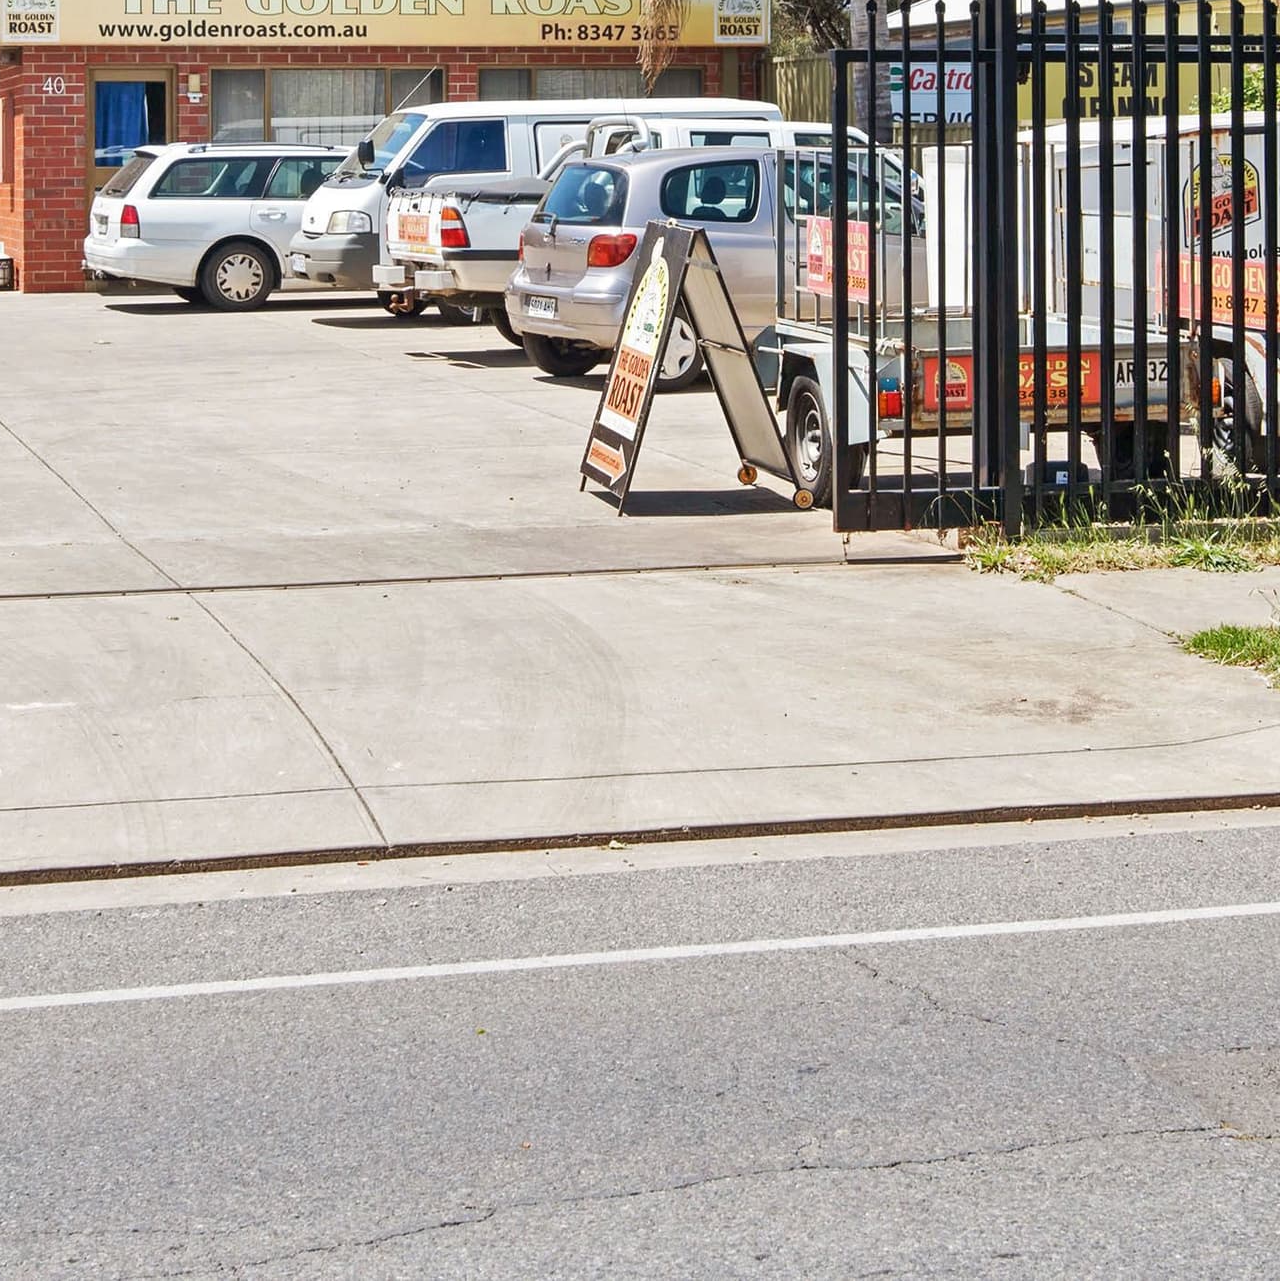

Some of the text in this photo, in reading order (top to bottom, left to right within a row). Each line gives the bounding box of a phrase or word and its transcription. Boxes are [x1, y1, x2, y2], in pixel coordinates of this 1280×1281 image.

[24, 13, 55, 21] GOLDEN
[9, 21, 53, 34] ROAST
[99, 20, 368, 42] www.goldenroast.com.au
[541, 23, 572, 41] Ph:
[577, 24, 625, 41] 8347
[719, 24, 759, 36] ROAST
[42, 76, 65, 94] 40
[607, 374, 644, 418] ROAST
